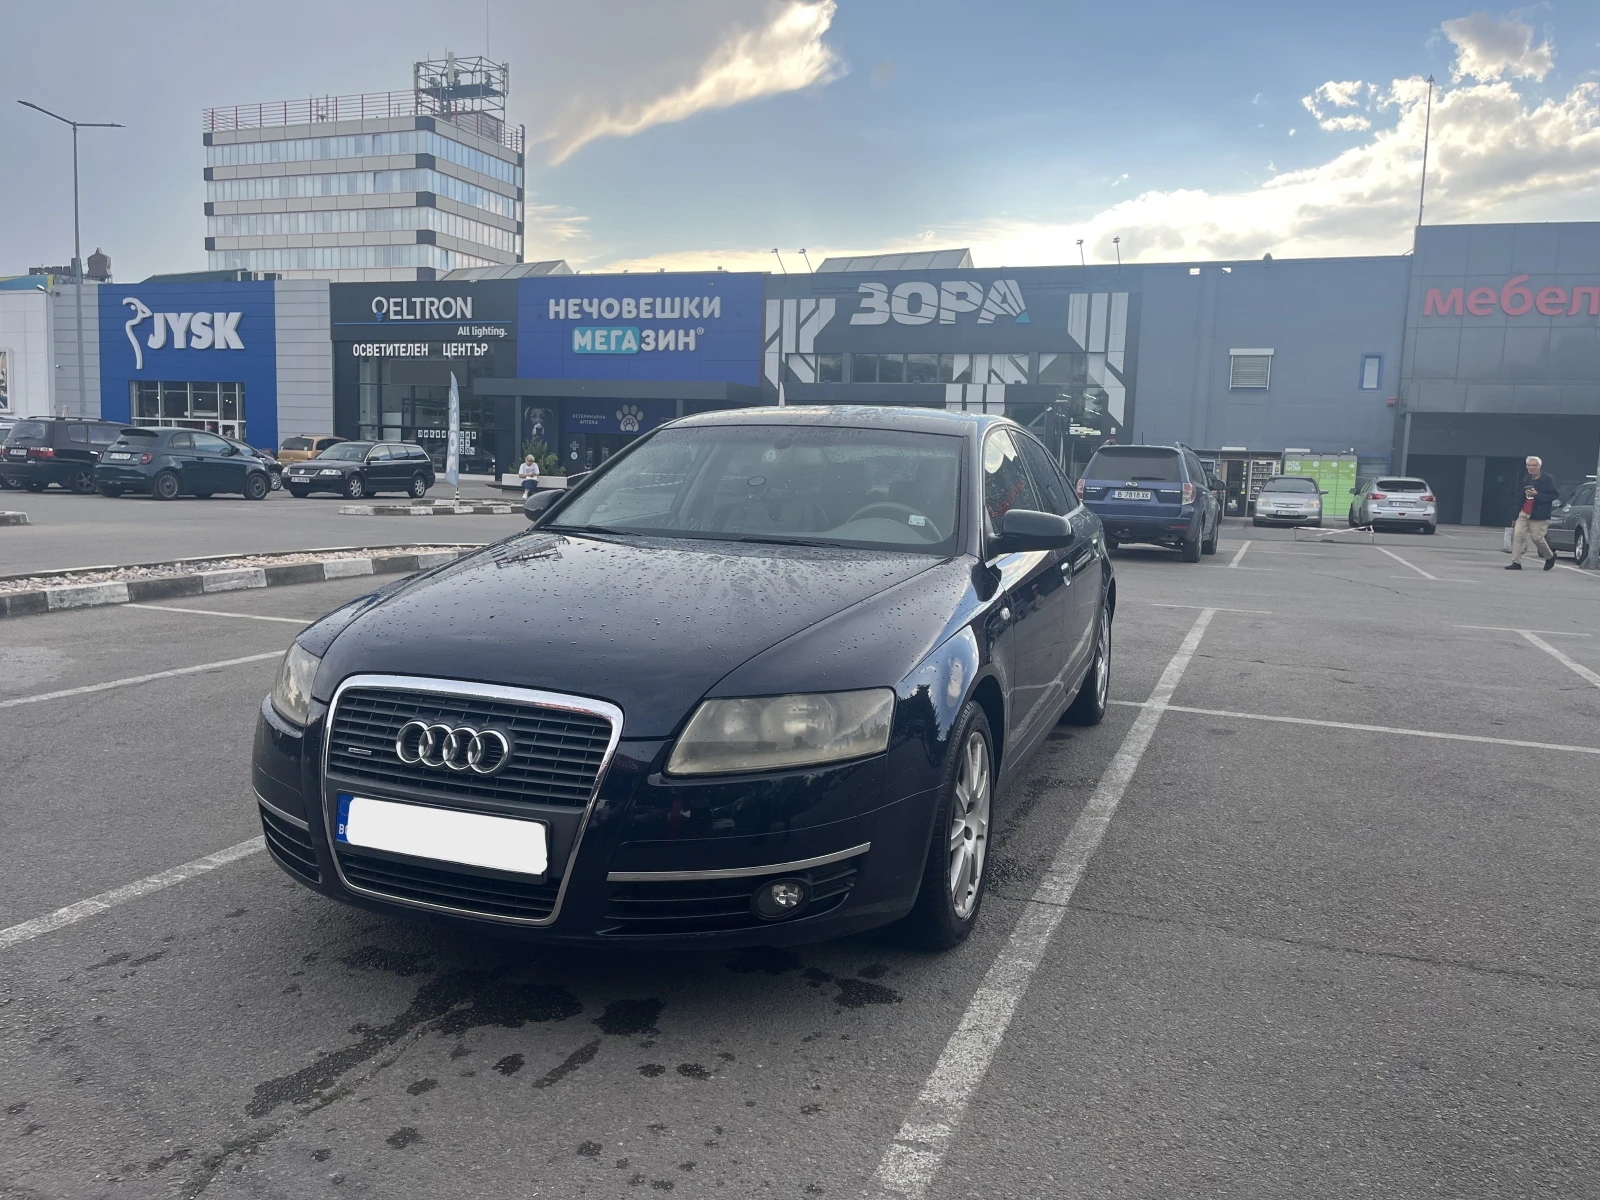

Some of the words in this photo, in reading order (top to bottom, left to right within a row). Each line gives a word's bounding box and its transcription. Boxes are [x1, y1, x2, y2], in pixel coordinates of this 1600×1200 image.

[549, 296, 721, 320] НЕЧОВЕШКИ
[850, 279, 1030, 325] ЗОРА
[1423, 274, 1600, 316] мебел
[147, 311, 245, 349] JYSK
[457, 326, 470, 336] All
[472, 326, 507, 338] lighting.
[352, 343, 429, 357] ОСВЕТИТЕЛЕН
[442, 343, 488, 358] ЦЕНТЪР
